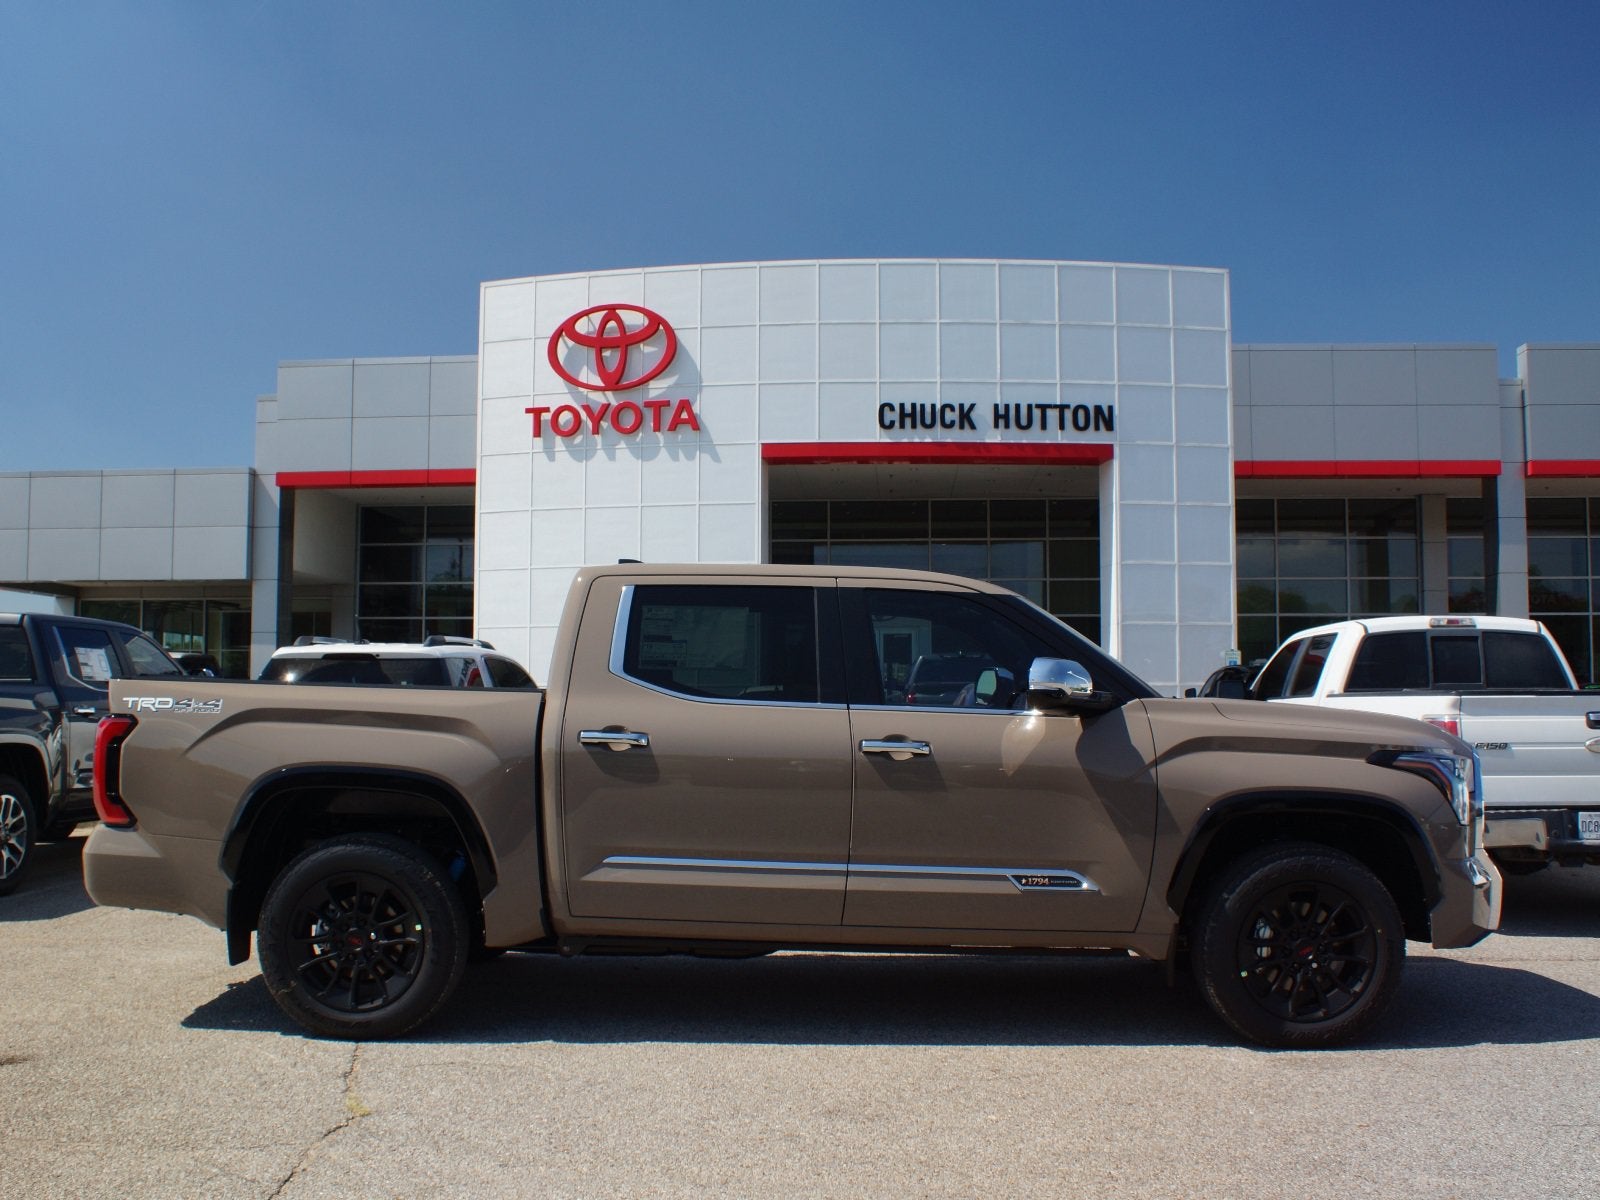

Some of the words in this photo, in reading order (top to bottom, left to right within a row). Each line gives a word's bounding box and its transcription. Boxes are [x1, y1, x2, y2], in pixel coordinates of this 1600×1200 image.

[525, 399, 700, 438] TOYOTA
[878, 402, 977, 430] CHUCK
[993, 403, 1114, 431] HUTTON
[123, 697, 173, 712] TRD
[1581, 820, 1600, 833] DC8
[1028, 877, 1050, 885] 1794
